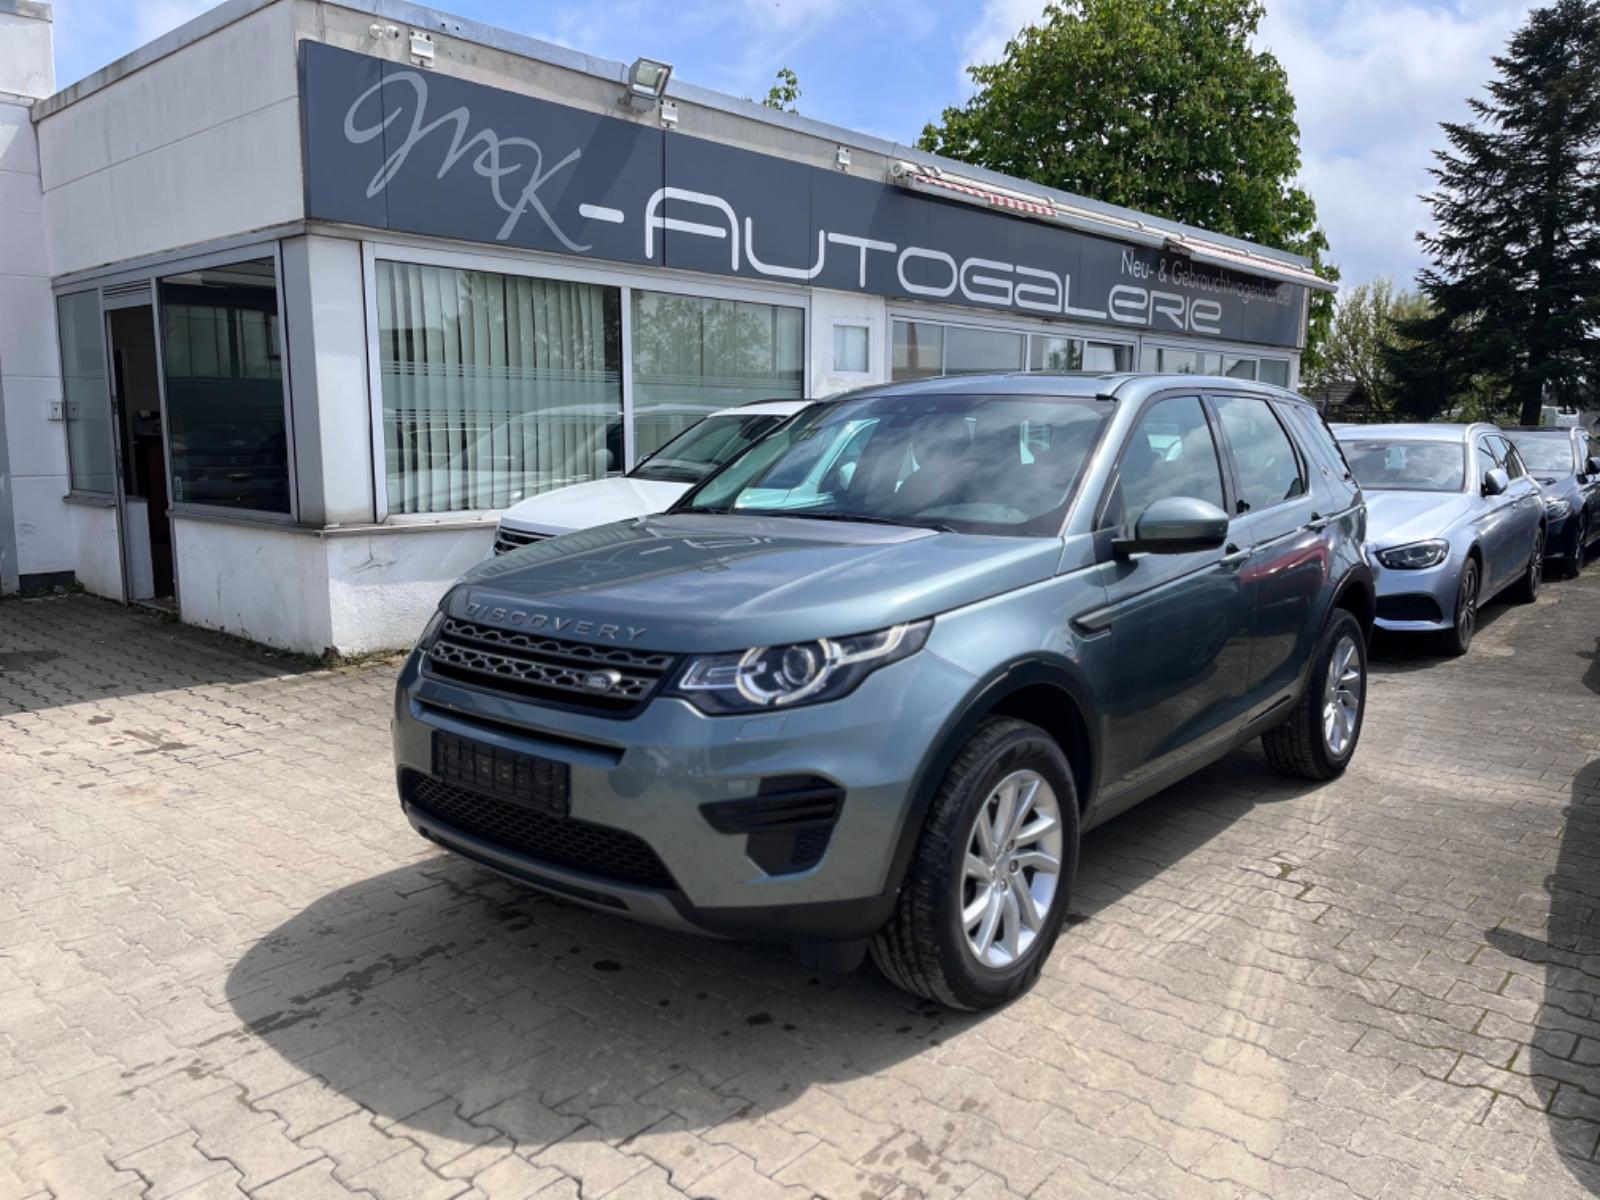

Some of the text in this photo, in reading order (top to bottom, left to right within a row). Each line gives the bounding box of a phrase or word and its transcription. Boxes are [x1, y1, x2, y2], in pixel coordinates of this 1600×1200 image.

[1121, 249, 1154, 279] Neu-
[1158, 258, 1167, 283] &
[465, 601, 648, 641] DISCOVERY
